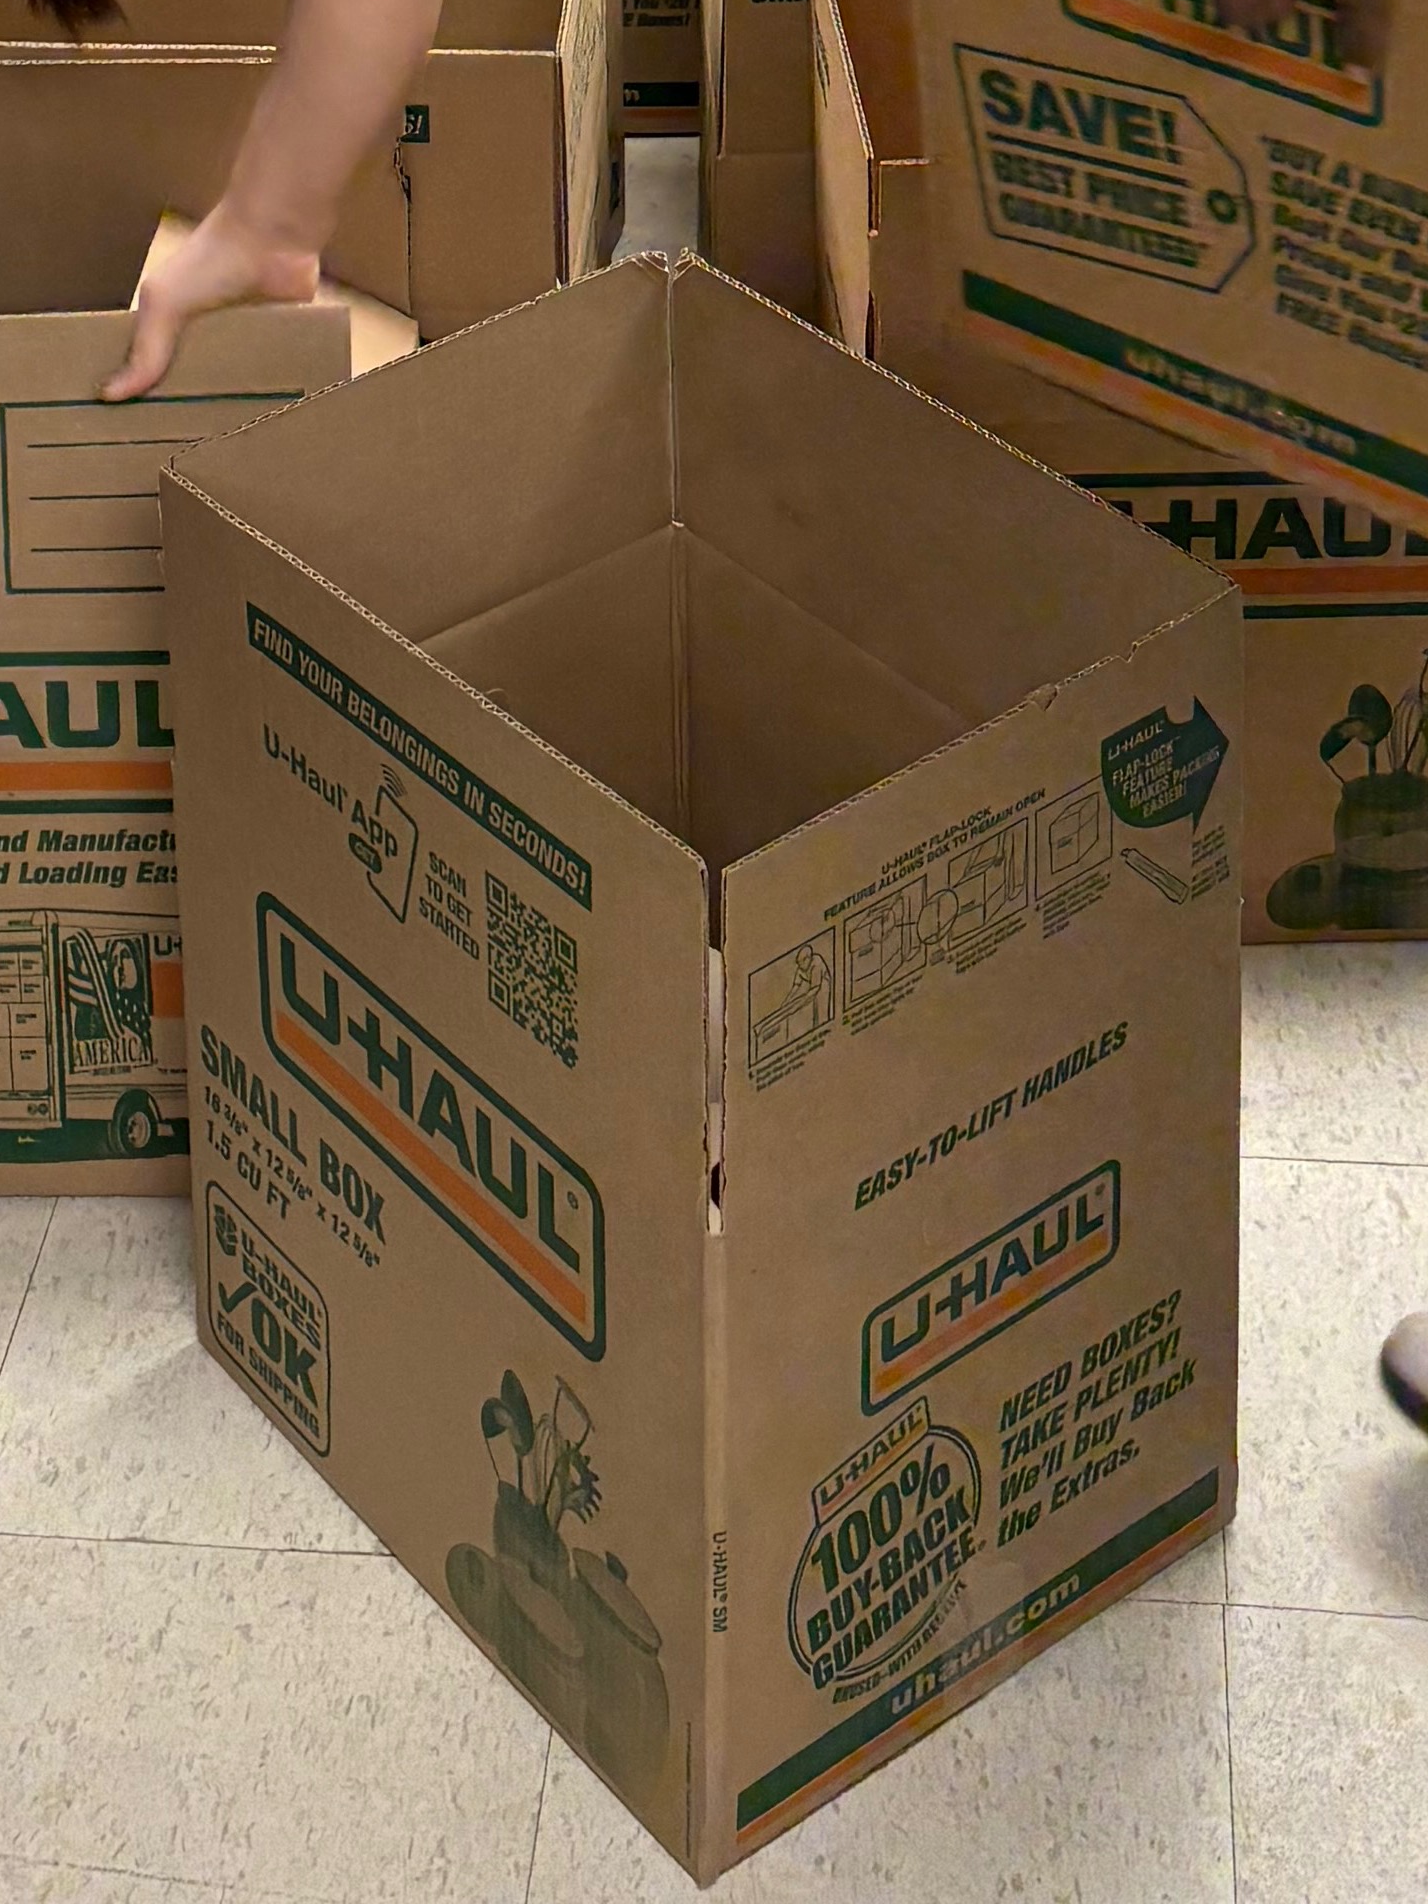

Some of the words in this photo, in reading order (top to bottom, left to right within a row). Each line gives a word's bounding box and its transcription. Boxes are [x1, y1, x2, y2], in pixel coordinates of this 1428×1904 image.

[979, 68, 1183, 165] SAVE!
[252, 617, 293, 667] FIND
[298, 650, 343, 704] YOUR
[346, 685, 460, 794] BELONGINGS
[463, 781, 486, 817] IN
[488, 800, 587, 895] SECONDS!
[19, 863, 127, 889] Loading
[350, 800, 399, 858] App
[428, 851, 468, 898] SCAN
[419, 896, 480, 960] STARTED
[423, 874, 444, 905] TO
[446, 890, 473, 929] GET
[200, 1024, 307, 1168] SMALL
[319, 1137, 386, 1246] BOX
[207, 1119, 231, 1161] 1.5
[237, 1151, 262, 1192] CU
[267, 1180, 291, 1220] FT
[854, 1086, 1019, 1211] EASY-TO-LIFT
[1021, 1021, 1129, 1108] HANDLES
[266, 1148, 284, 1179] 12
[332, 1213, 350, 1246] 12
[241, 1251, 321, 1352] BOXES
[250, 1296, 319, 1409] OK
[216, 1309, 245, 1357] FOR
[247, 1345, 320, 1440] SHIPPING
[999, 1360, 1073, 1434] NEED
[1079, 1288, 1182, 1381] BOXES?
[1001, 1400, 1069, 1471] TAKE
[1073, 1325, 1182, 1423] PLENTY!
[999, 1439, 1067, 1510] We'll
[1072, 1406, 1125, 1461] Buy
[1129, 1357, 1197, 1422] Back
[811, 1442, 951, 1594] 100%
[997, 1500, 1042, 1549] the
[1049, 1437, 1140, 1514] Extras.
[712, 1605, 728, 1633] SM
[806, 1485, 971, 1656] BUY-BACK
[890, 1574, 1080, 1715] uhaul.com
